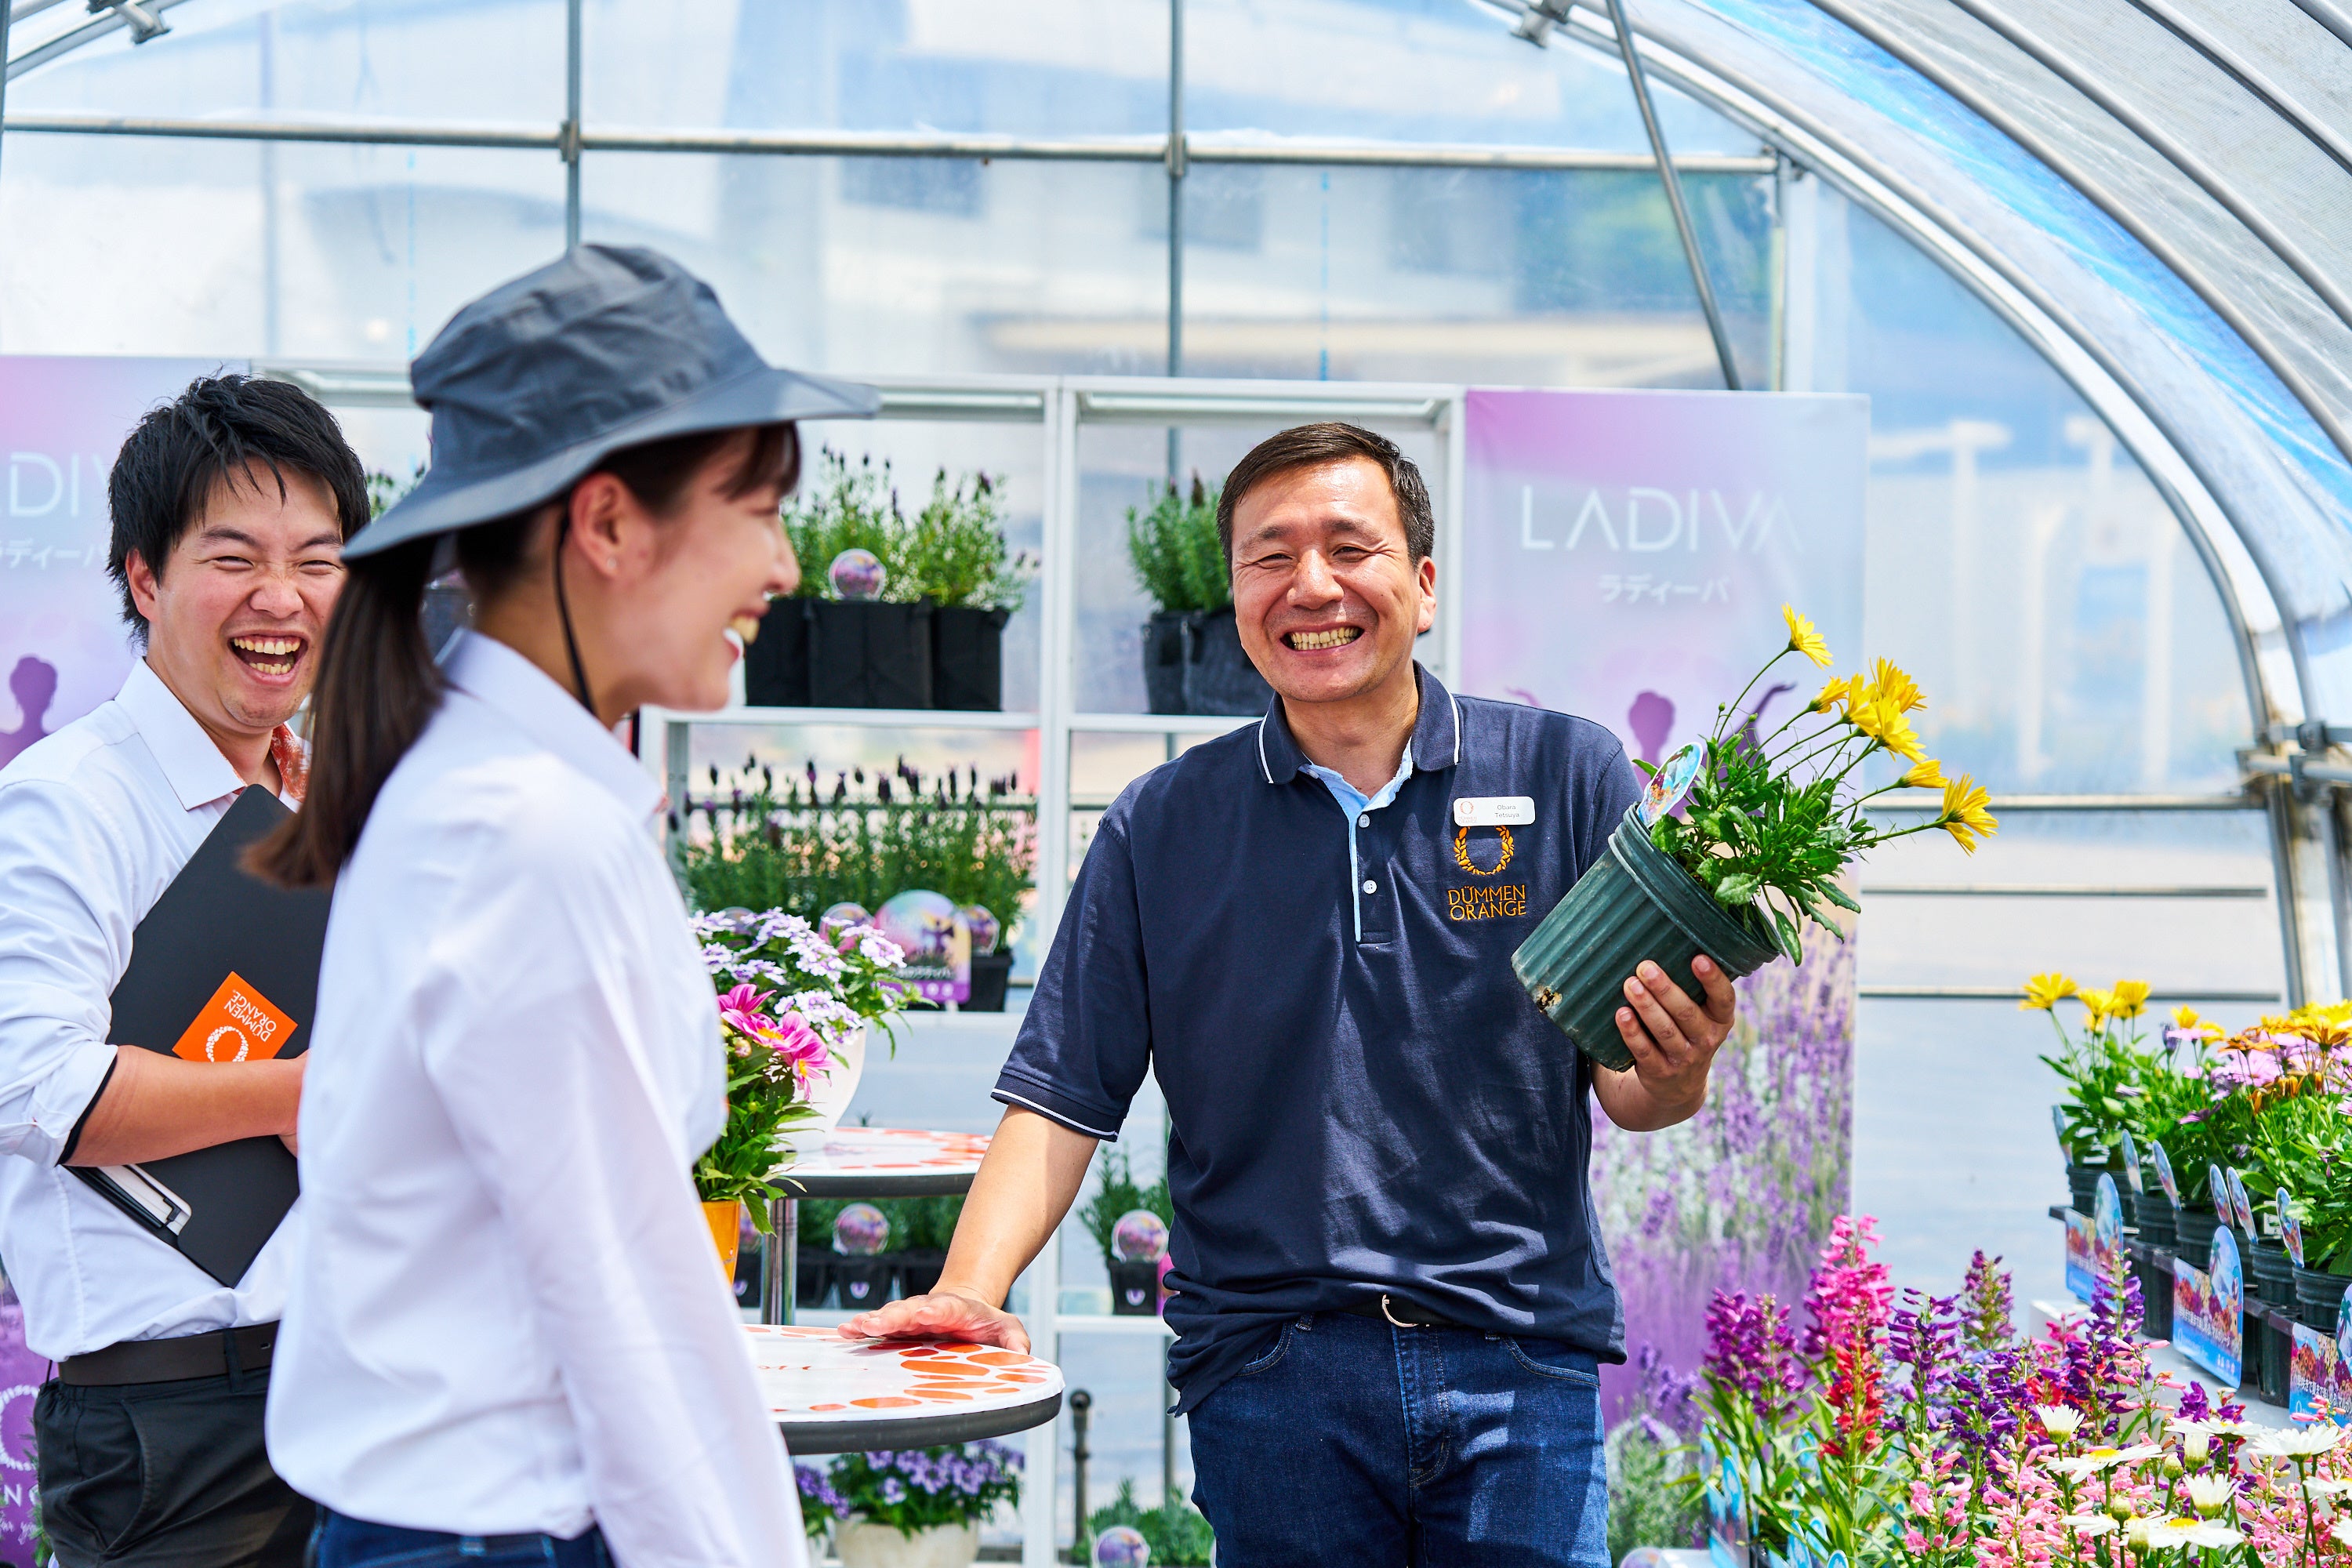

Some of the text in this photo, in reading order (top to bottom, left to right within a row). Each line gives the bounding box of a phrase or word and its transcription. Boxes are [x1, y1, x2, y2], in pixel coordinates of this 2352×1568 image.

[1521, 485, 1805, 552] LADIVA
[1598, 572, 1732, 606] ラディーバ
[1447, 884, 1526, 906] DÜMMEN
[1450, 900, 1527, 921] ORANGE
[223, 1000, 271, 1043] DÜMMEN
[231, 990, 277, 1033] ORANGE
